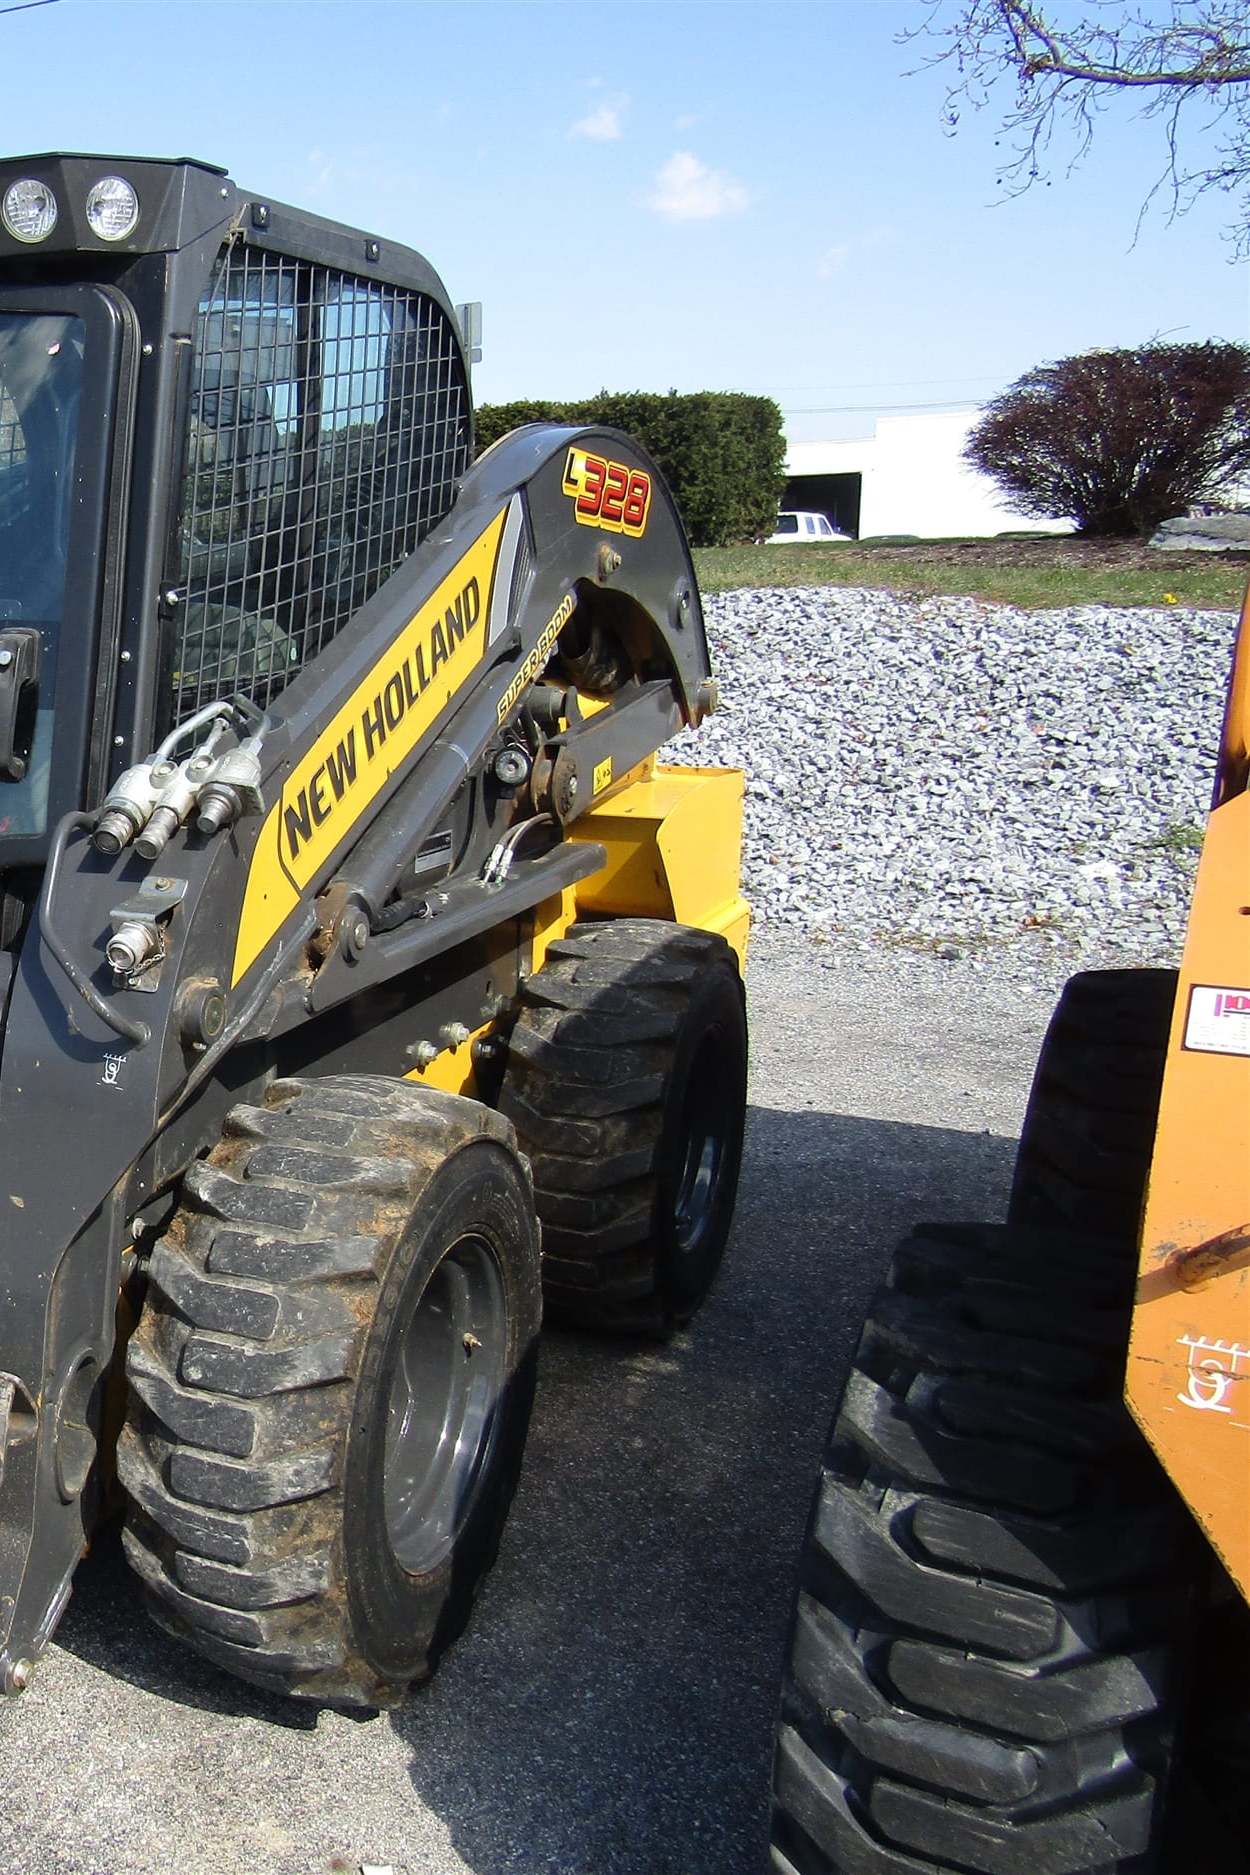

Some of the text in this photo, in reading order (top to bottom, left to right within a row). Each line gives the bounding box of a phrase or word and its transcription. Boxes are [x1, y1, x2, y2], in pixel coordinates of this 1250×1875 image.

[283, 576, 480, 861] NEW HOLLAND
[497, 594, 572, 725] SUPER BOOM
